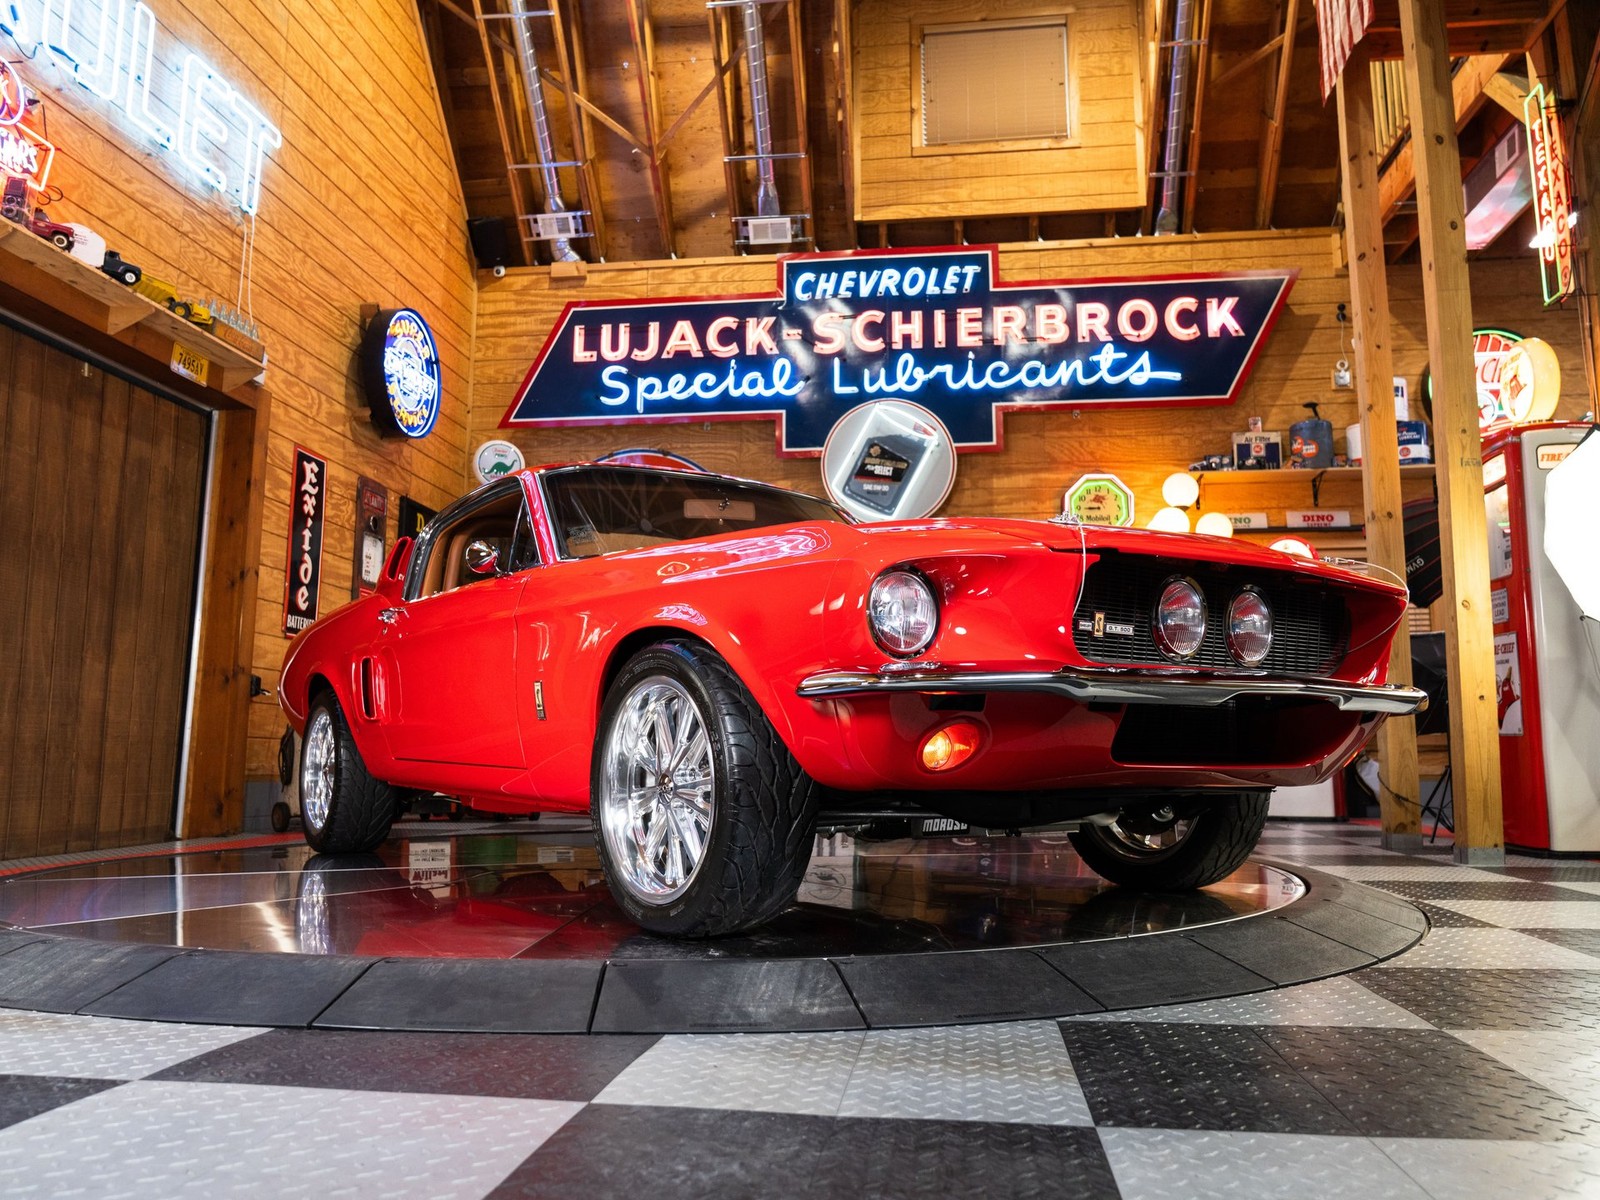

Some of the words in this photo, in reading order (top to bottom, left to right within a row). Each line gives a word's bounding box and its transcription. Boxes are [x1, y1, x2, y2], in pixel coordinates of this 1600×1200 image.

[793, 264, 982, 301] CHEVROLET
[599, 357, 810, 414] Special
[833, 342, 1182, 397] Lubricants
[296, 460, 320, 611] Exide
[1302, 514, 1334, 522] DINO
[1494, 642, 1515, 656] RE-CHIEF
